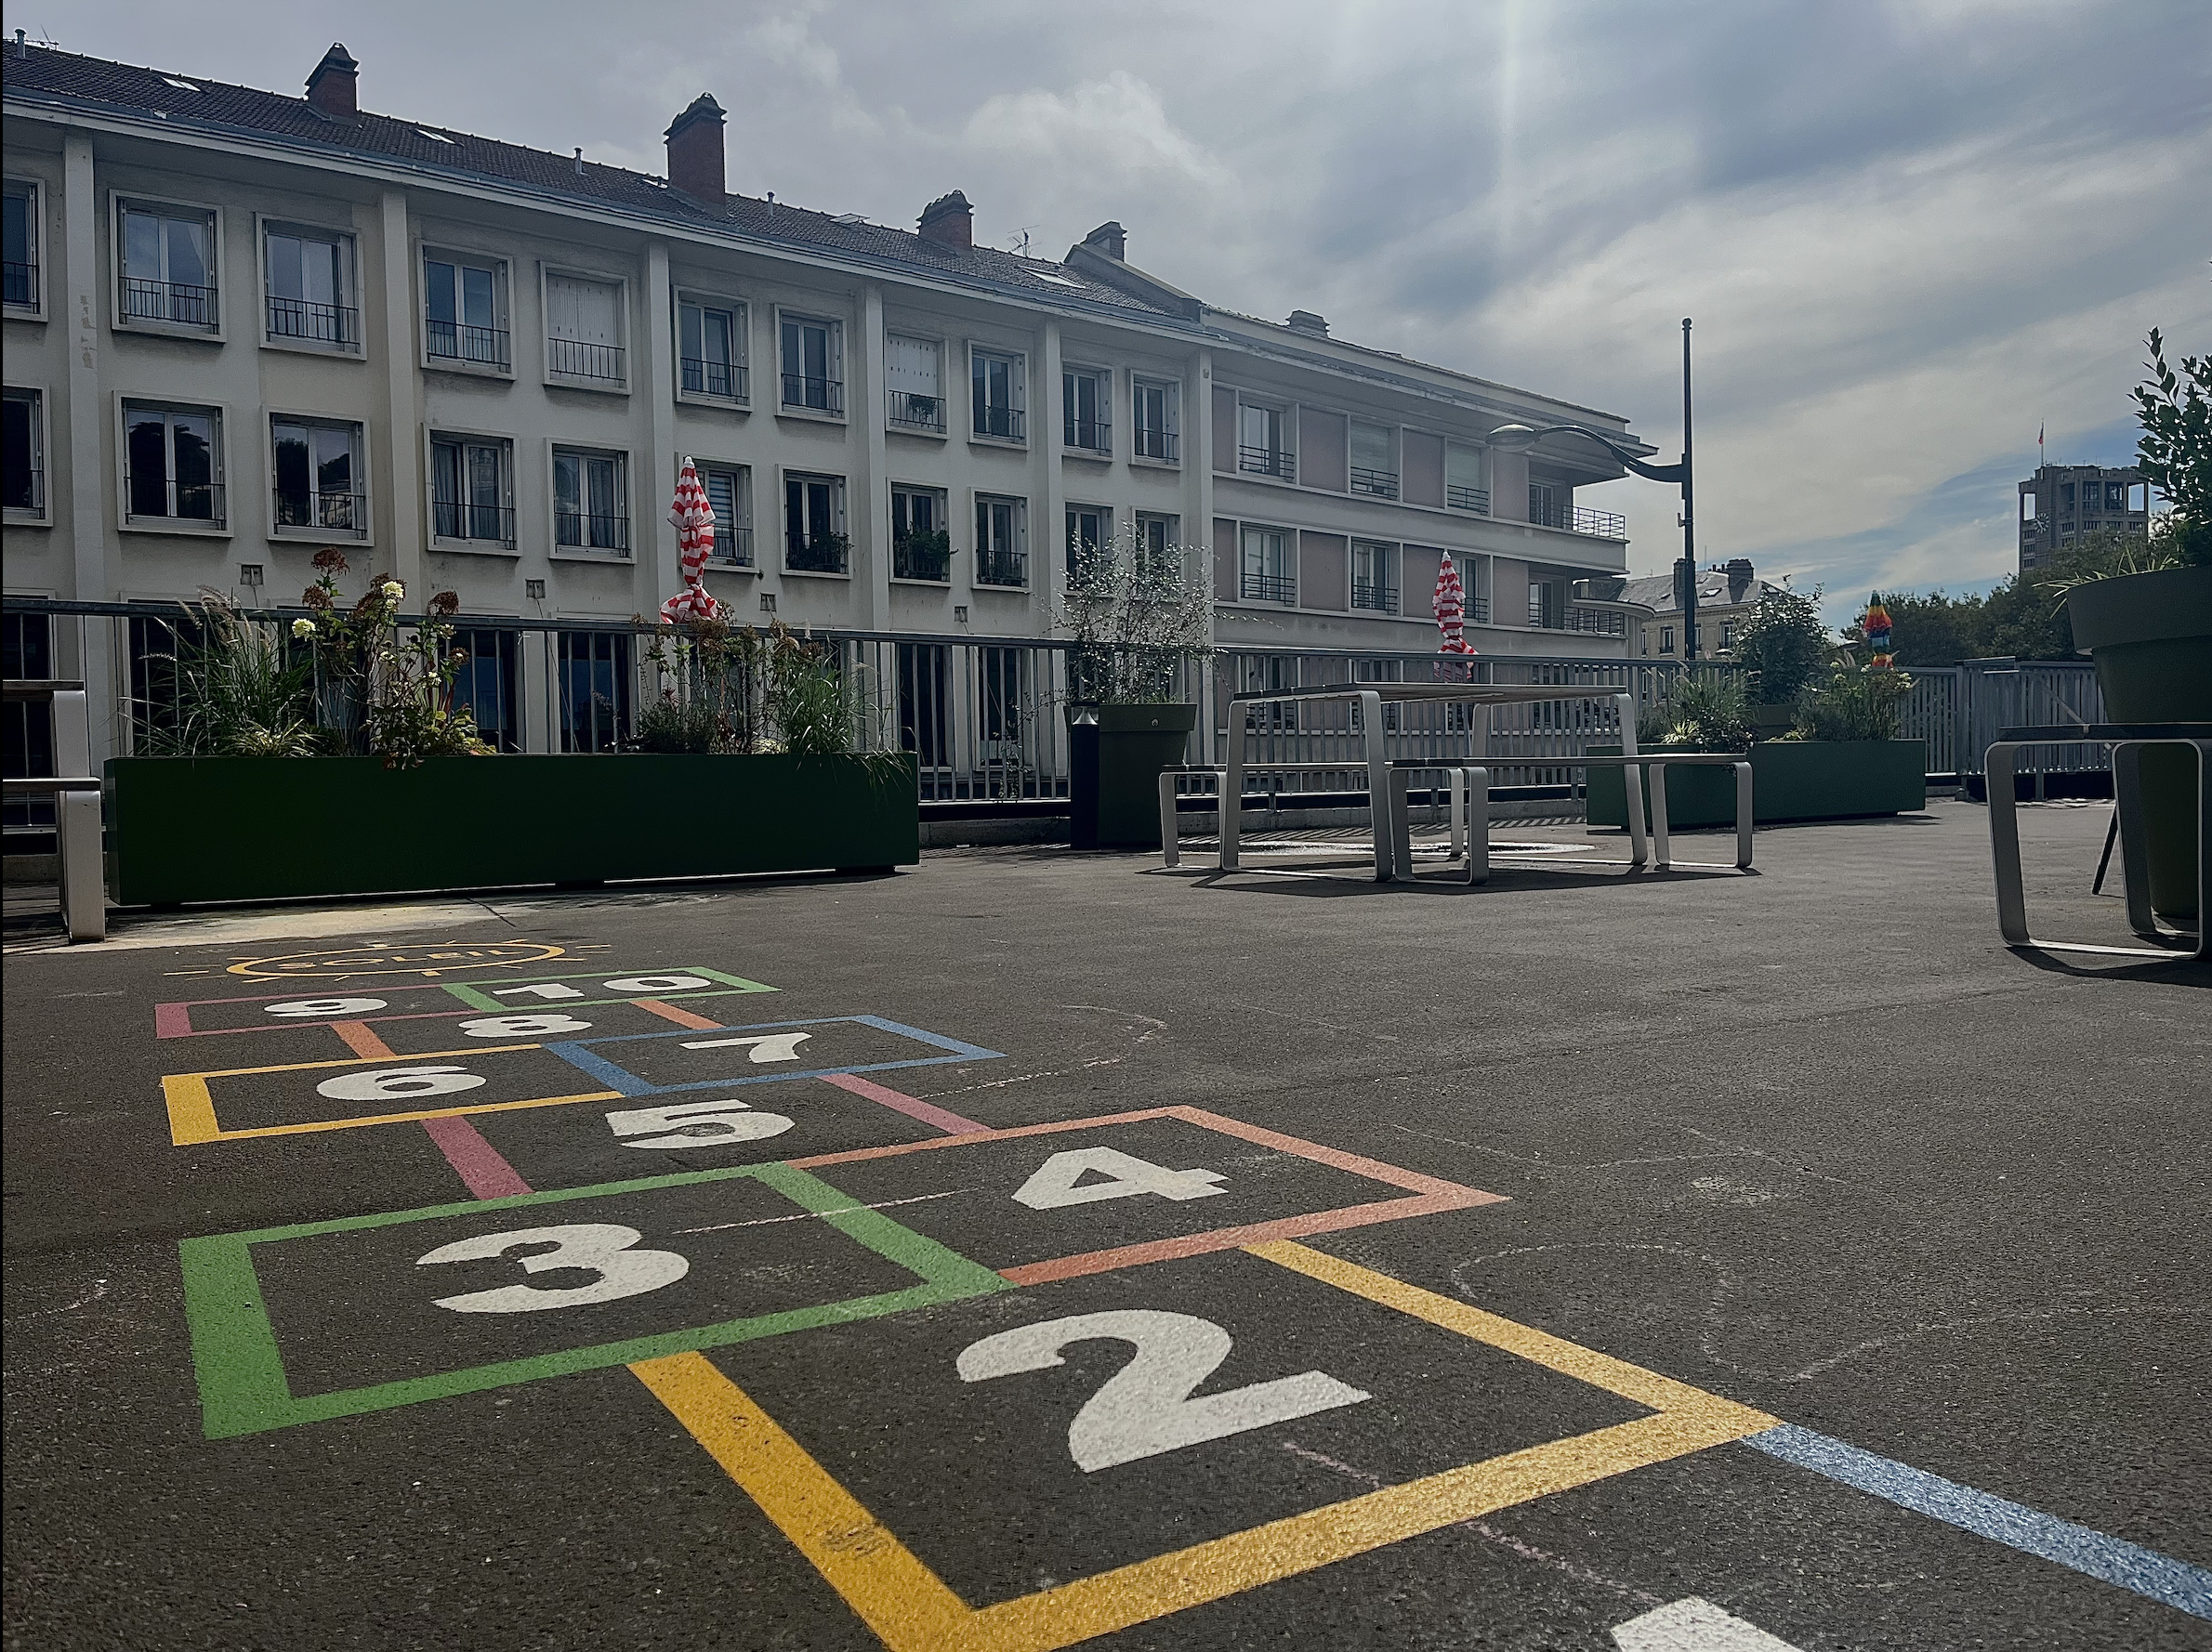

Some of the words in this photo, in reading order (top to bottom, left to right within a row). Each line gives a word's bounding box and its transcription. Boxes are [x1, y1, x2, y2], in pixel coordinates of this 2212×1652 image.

[277, 951, 525, 969] SOLEIL
[493, 976, 712, 1000] 10
[264, 997, 388, 1017] 9
[459, 1014, 593, 1038] 8
[680, 1032, 813, 1064] 7
[317, 1066, 487, 1101] 6
[605, 1098, 796, 1149] 5
[1011, 1147, 1229, 1211] 4
[415, 1222, 690, 1316] 3
[956, 1309, 1371, 1473] 2
